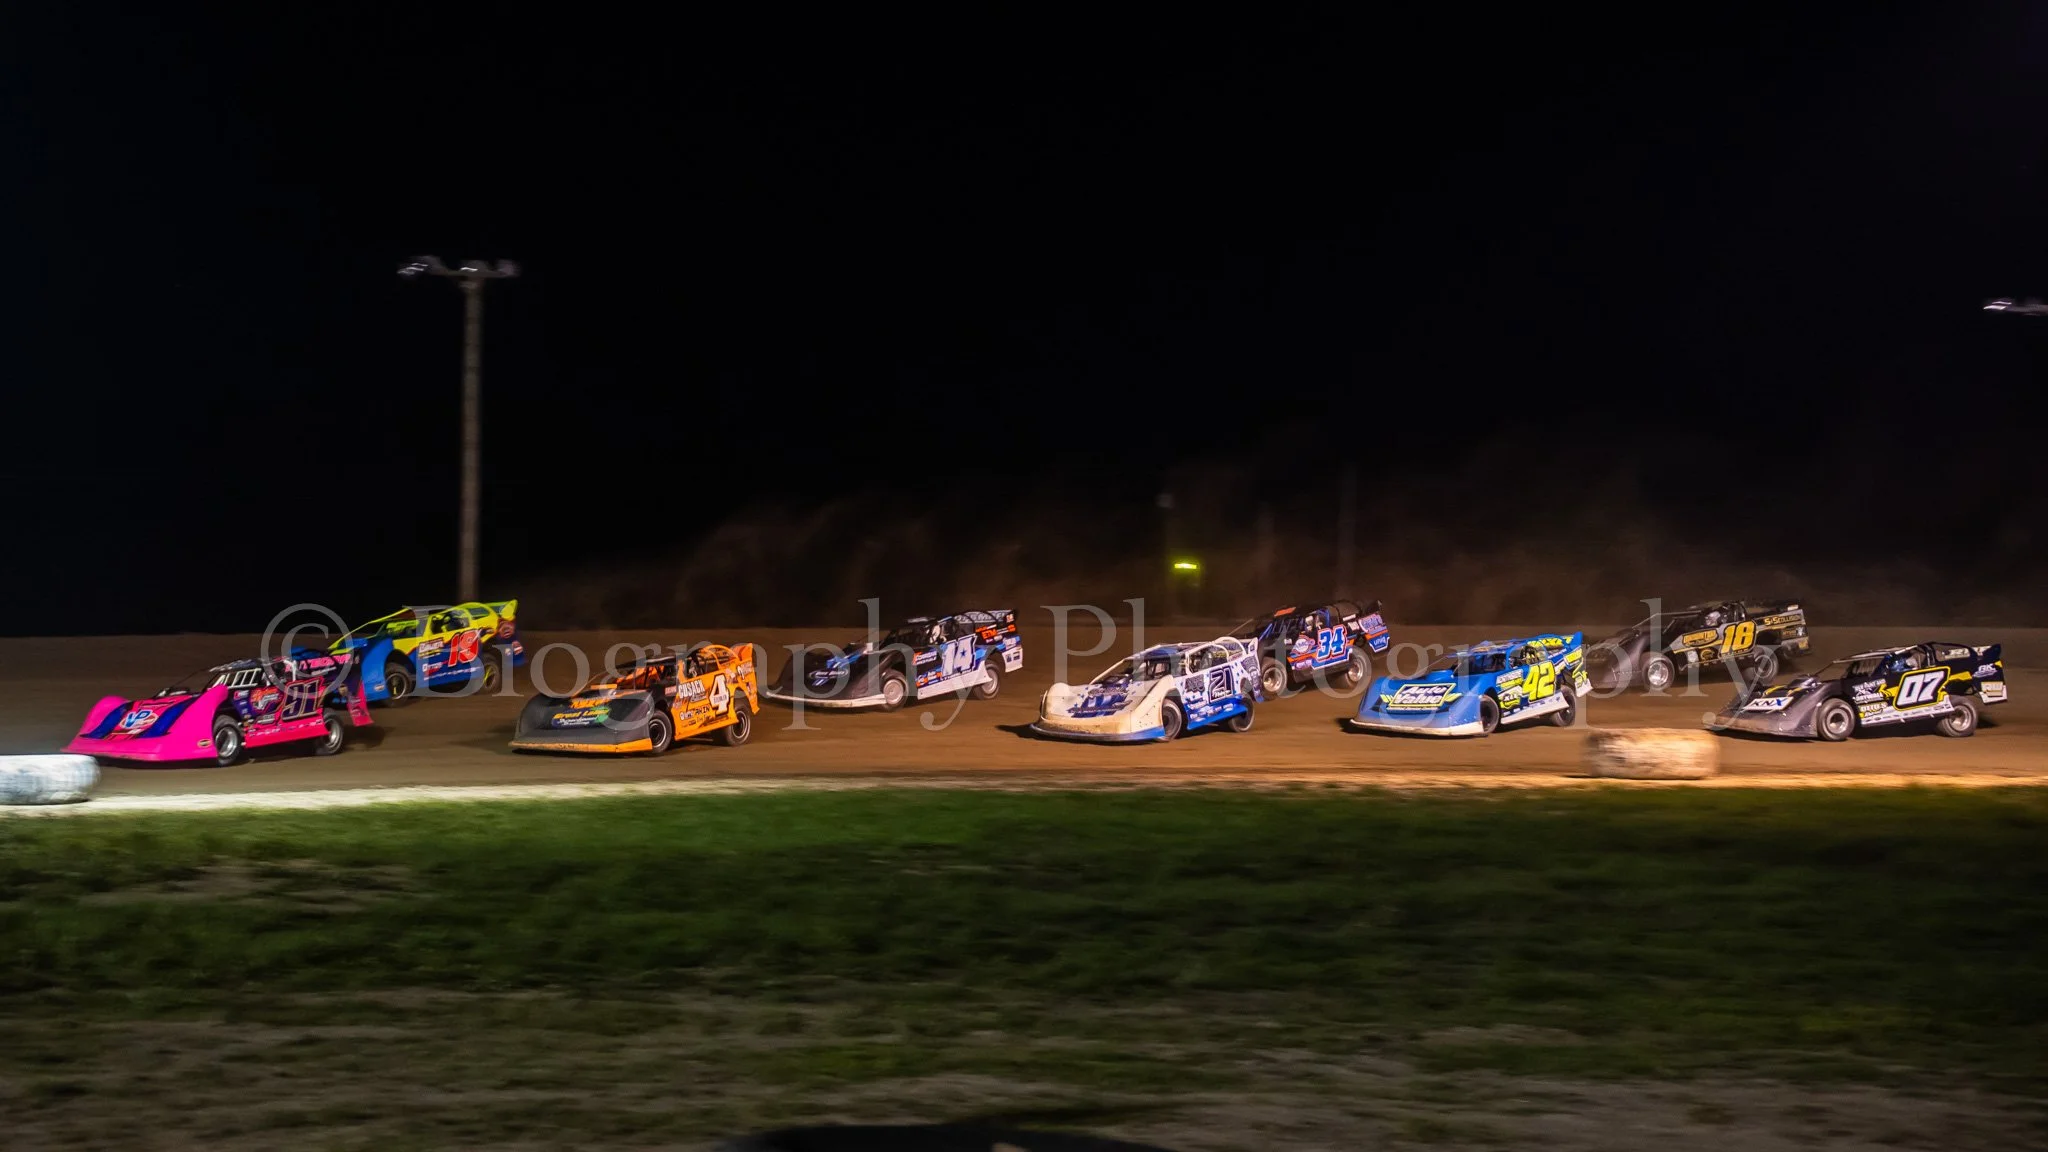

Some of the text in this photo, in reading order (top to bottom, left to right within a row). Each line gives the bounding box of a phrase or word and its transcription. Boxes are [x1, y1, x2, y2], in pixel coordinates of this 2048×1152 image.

[1316, 625, 1346, 661] 34
[1720, 619, 1756, 655] 18
[941, 633, 978, 678] 14
[709, 673, 730, 715] 4
[1208, 665, 1235, 702] 21
[1393, 693, 1443, 704] Value
[1401, 686, 1448, 695] Auto
[1522, 660, 1556, 702] 42
[1896, 670, 1945, 706] 07
